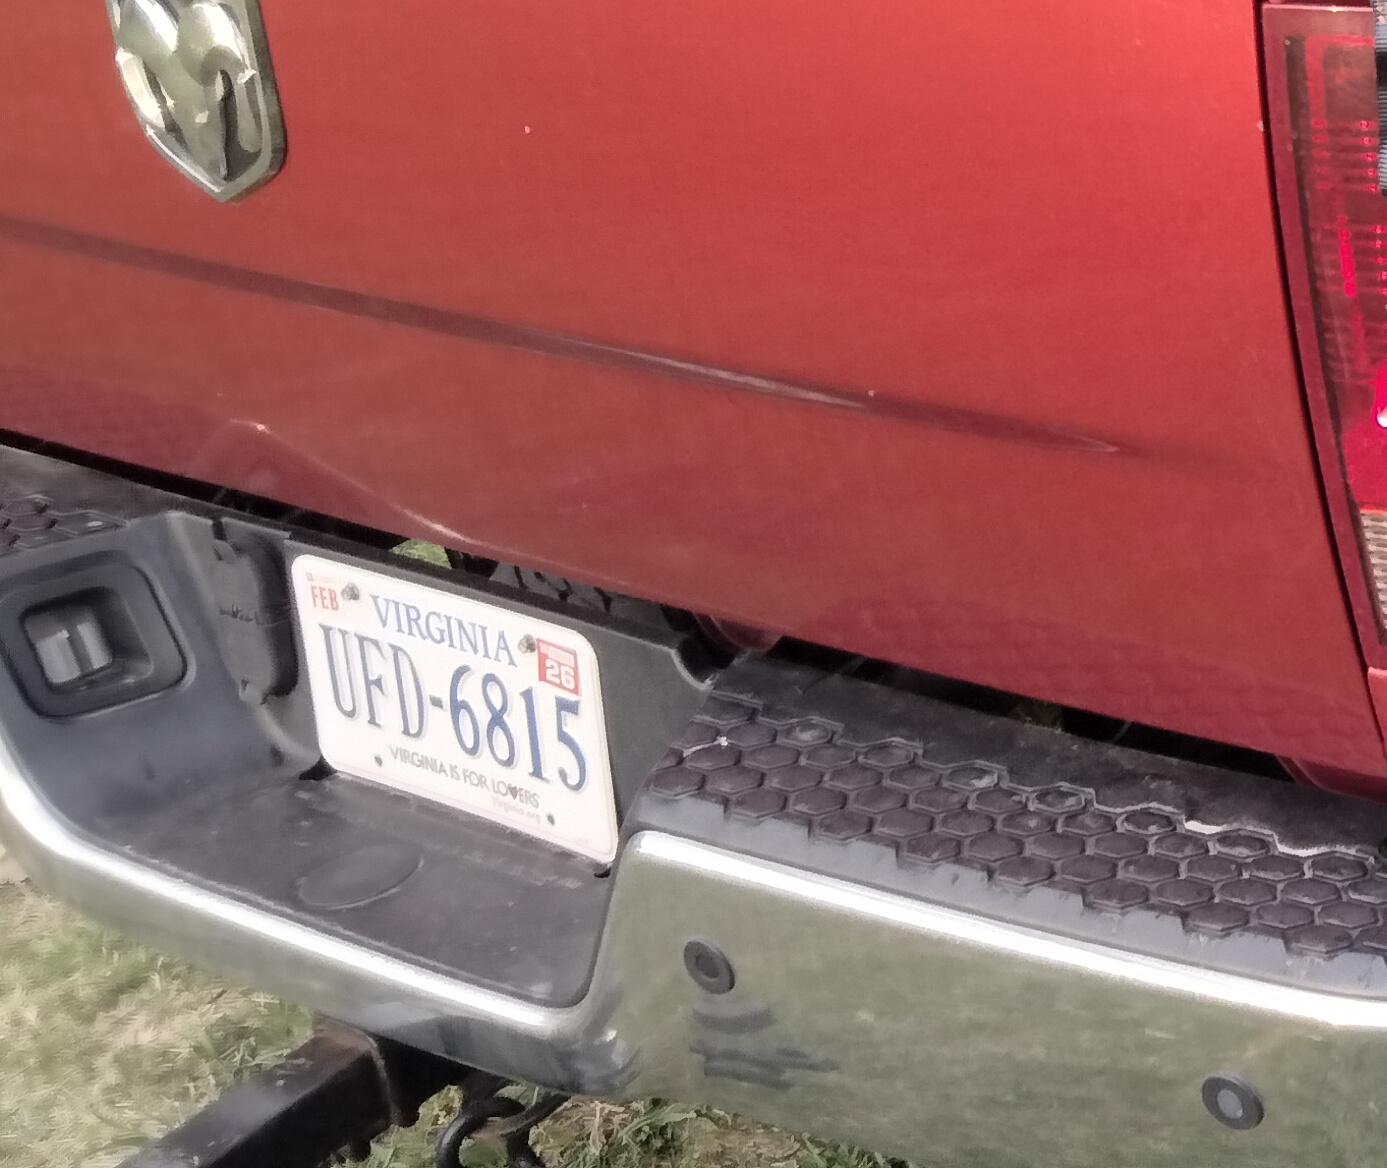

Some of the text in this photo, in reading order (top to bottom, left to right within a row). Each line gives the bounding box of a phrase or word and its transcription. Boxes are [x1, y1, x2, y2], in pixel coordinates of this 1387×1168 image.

[310, 583, 339, 611] FEB
[369, 593, 518, 668] VIRGINIA
[545, 657, 576, 690] 26
[317, 622, 589, 794] UFD-6815
[389, 744, 449, 778] VIRGINIA
[449, 763, 461, 782] IS
[463, 768, 490, 792] FOR
